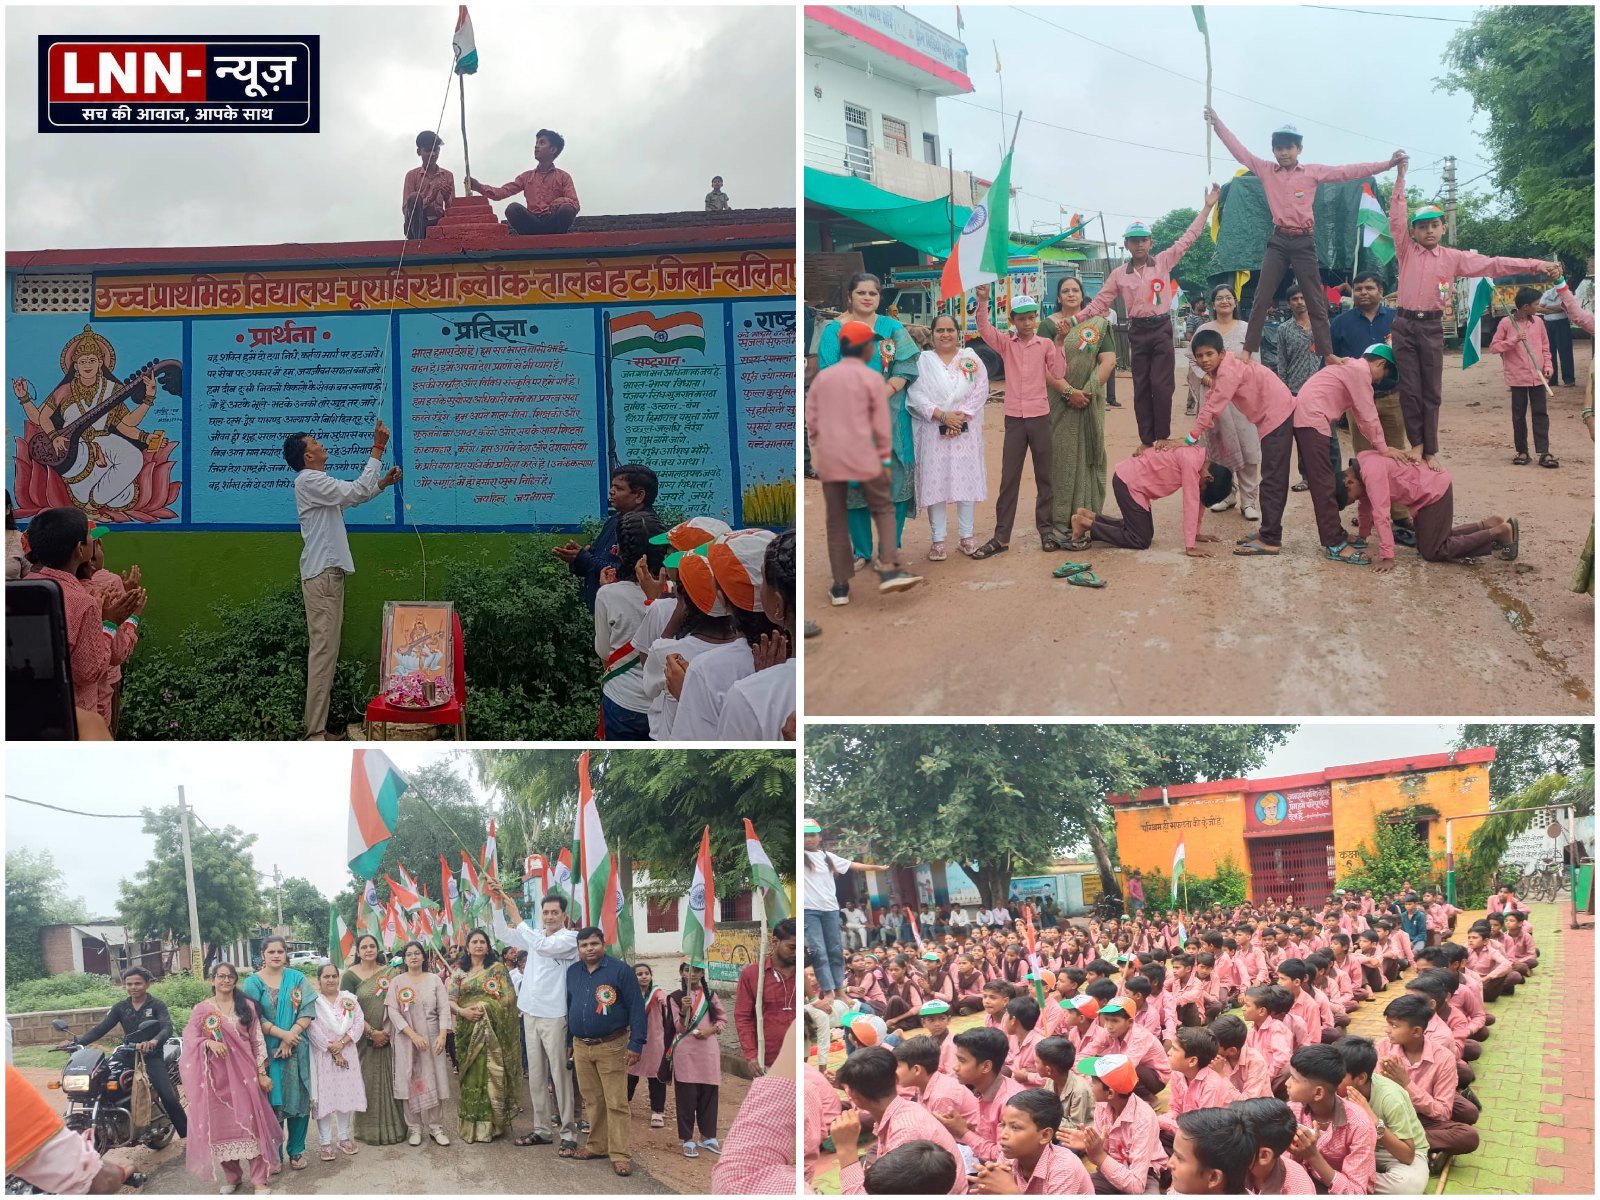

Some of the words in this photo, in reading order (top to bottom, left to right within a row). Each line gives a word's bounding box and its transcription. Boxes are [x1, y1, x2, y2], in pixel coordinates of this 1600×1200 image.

[150, 274, 243, 312] प्राथमिक
[248, 320, 317, 348] प्रार्थना
[454, 313, 528, 344] प्रतिज्ञा
